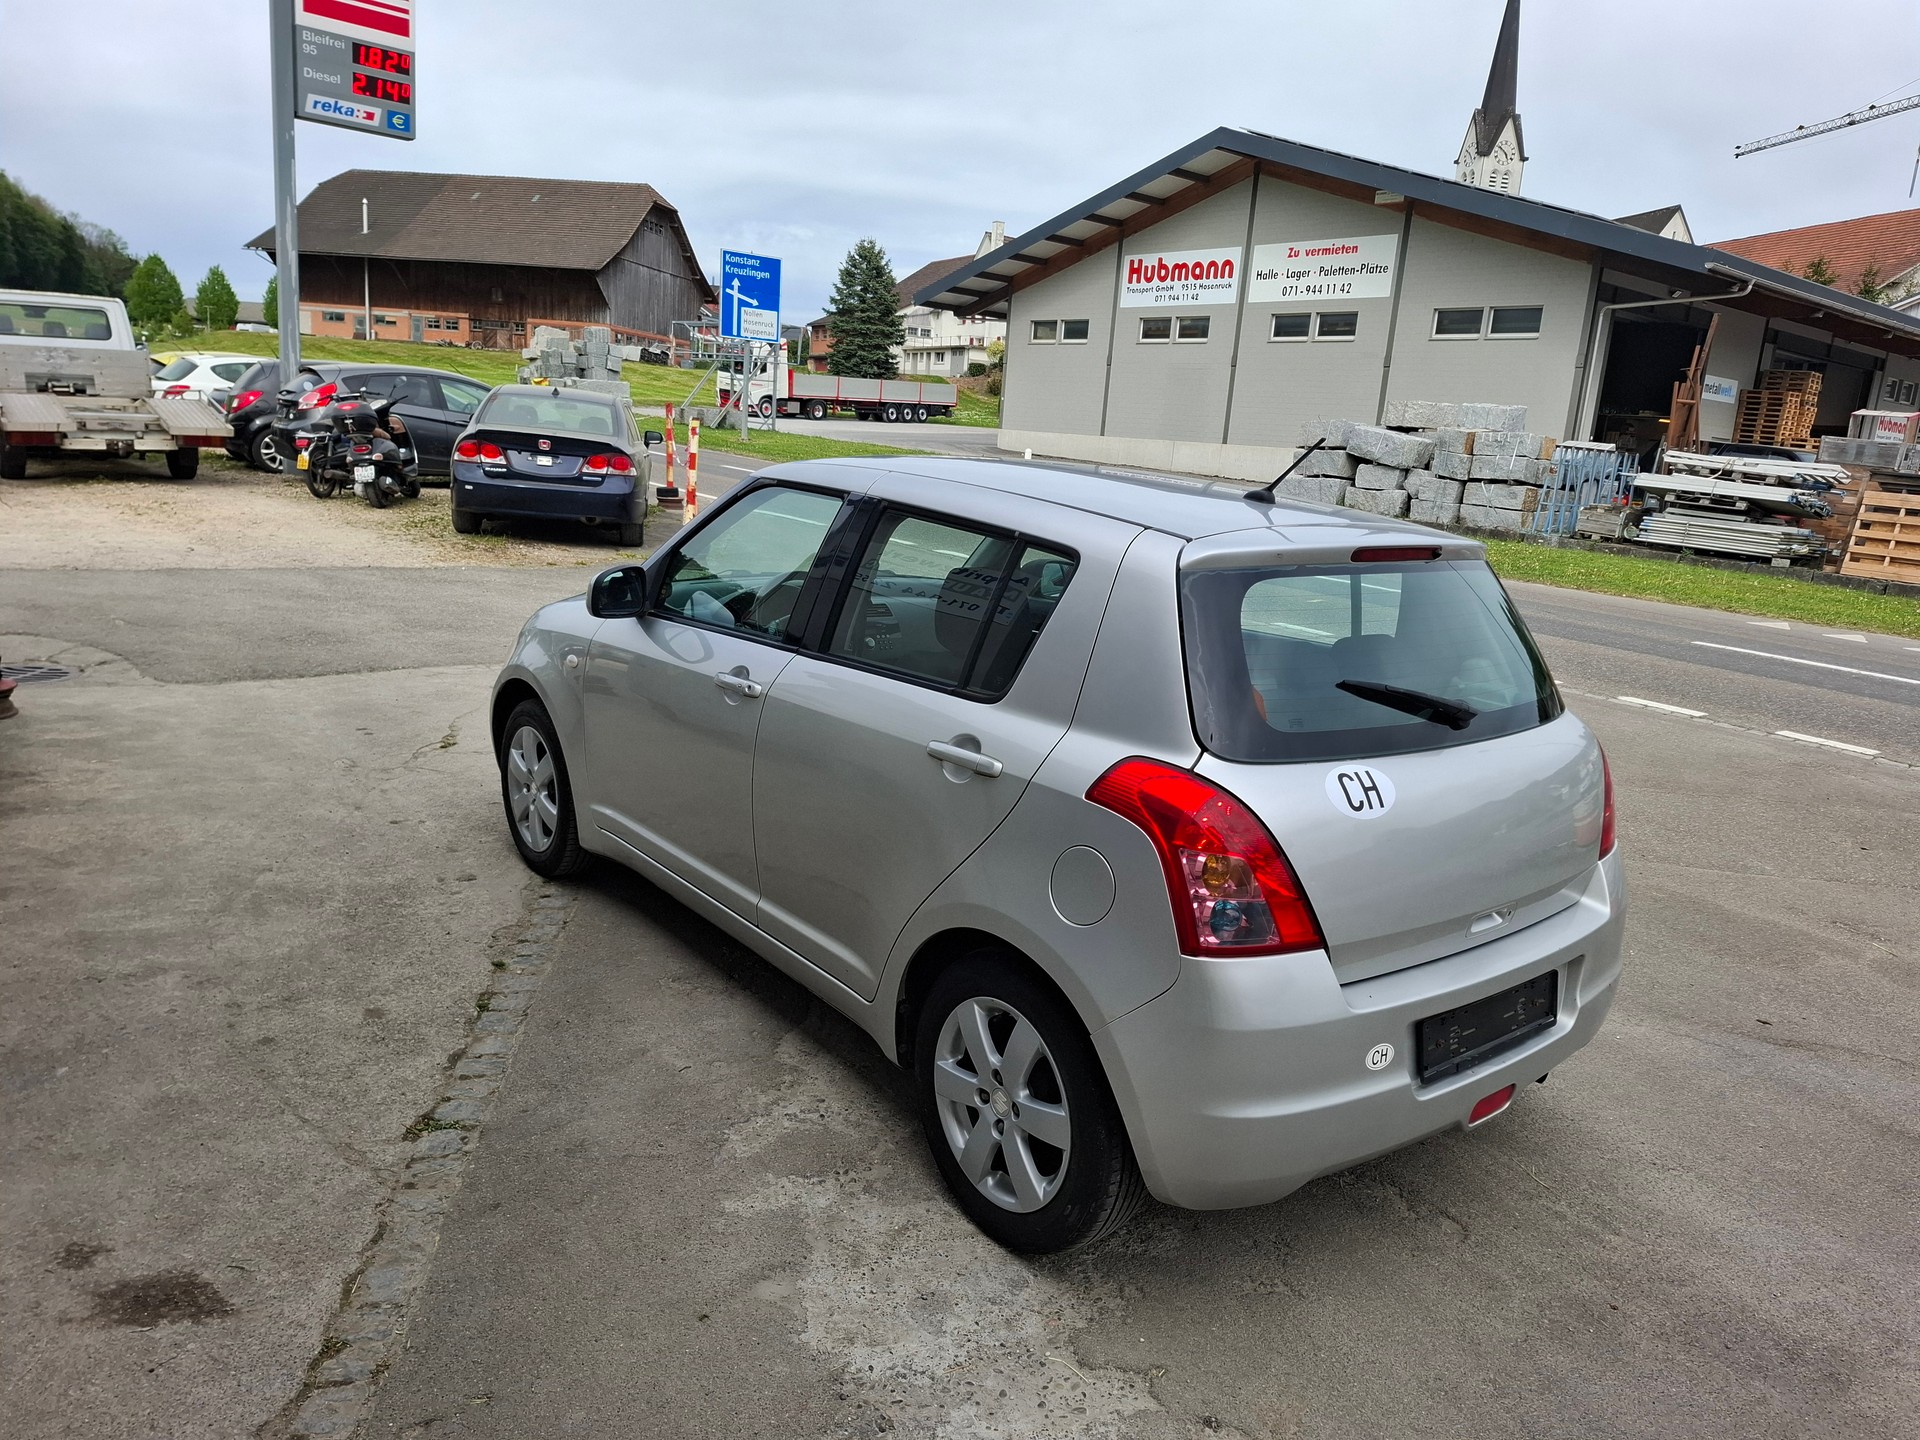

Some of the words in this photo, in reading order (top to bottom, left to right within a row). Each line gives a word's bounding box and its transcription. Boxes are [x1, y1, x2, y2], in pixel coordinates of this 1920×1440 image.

[302, 30, 345, 49] Bleifrei
[302, 43, 317, 55] 95
[303, 67, 341, 84] Diesel
[1287, 247, 1300, 258] Zu
[1305, 243, 1359, 257] vermieten
[725, 253, 760, 267] Konstanz
[725, 264, 770, 280] Kreuzlingen
[1127, 256, 1235, 284] Hubmann
[1256, 268, 1279, 280] Halle
[1286, 268, 1311, 281] Lager
[1318, 262, 1389, 277] Paletten-Plätze
[1126, 286, 1154, 294] Transport
[1155, 284, 1175, 293] GmbH
[1181, 283, 1197, 291] 9515
[1198, 281, 1232, 290] Hosenruck
[1326, 283, 1336, 294] 11
[1340, 282, 1352, 294] 42
[1154, 294, 1166, 303] 071
[1168, 293, 1180, 301] 944
[1182, 293, 1189, 301] 11
[1190, 293, 1199, 301] 42
[743, 309, 763, 318] Nollen
[743, 318, 774, 328] Hosenruck
[743, 328, 775, 337] Wuppenau
[1877, 416, 1907, 434] Hubman
[1337, 770, 1385, 812] CH
[1371, 1047, 1389, 1065] CH
